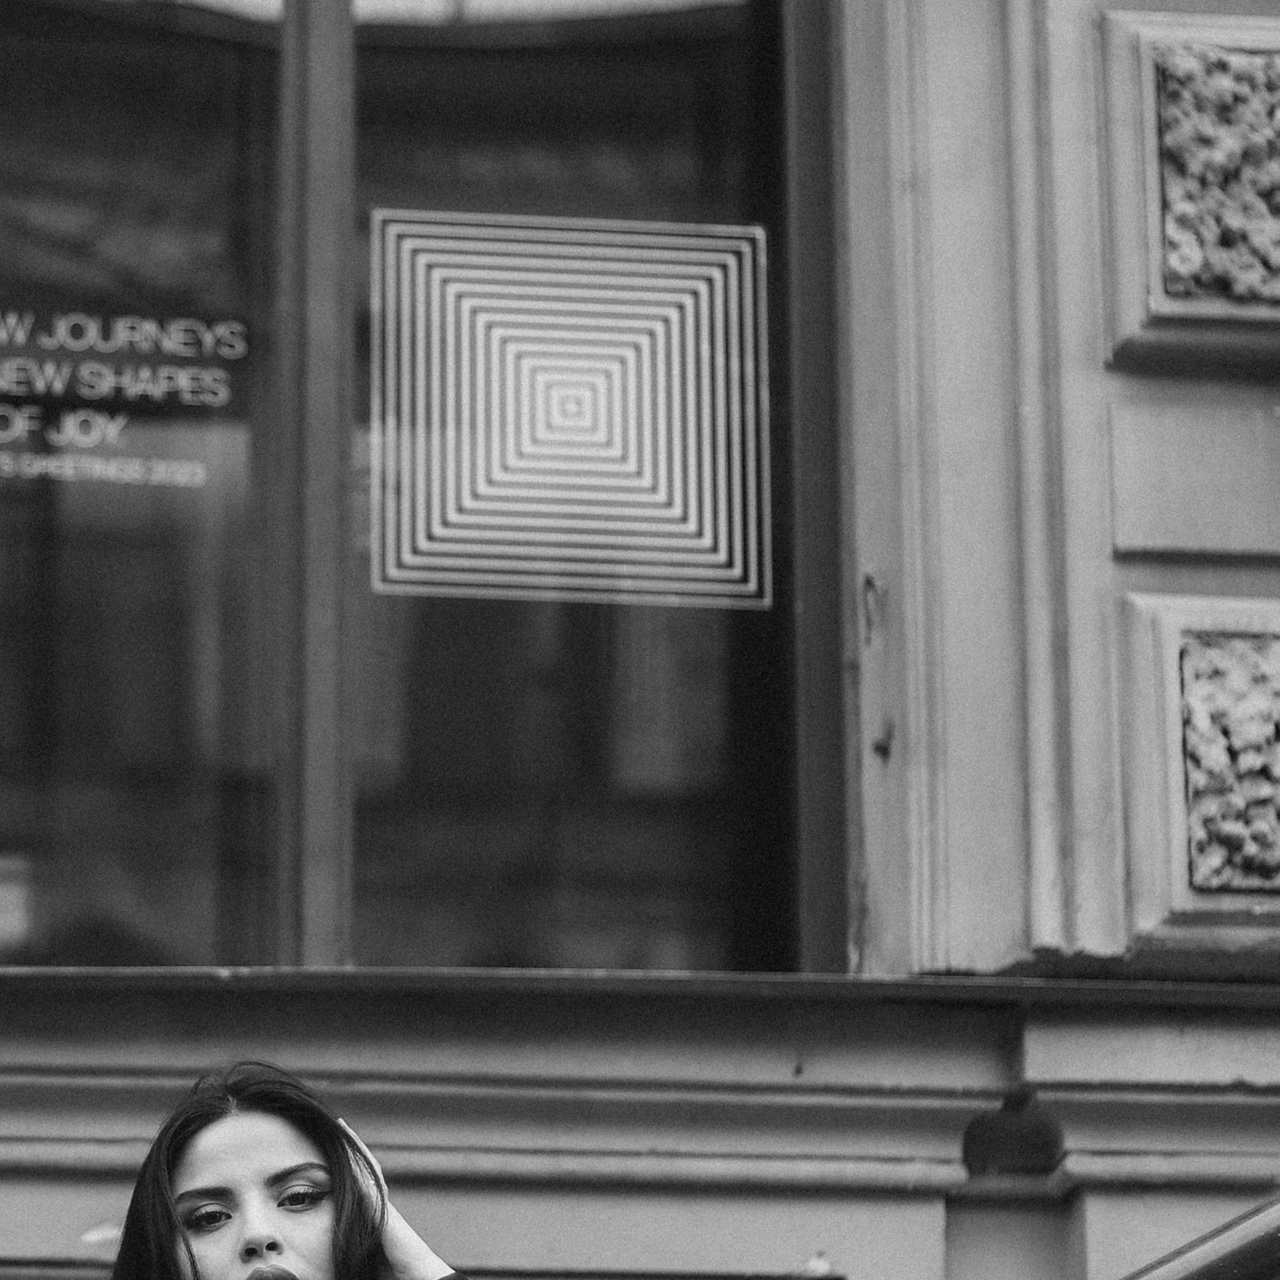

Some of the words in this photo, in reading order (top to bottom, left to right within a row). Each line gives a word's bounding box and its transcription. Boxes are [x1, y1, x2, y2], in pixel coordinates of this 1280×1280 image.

[38, 312, 248, 359] JOURNEYS
[77, 361, 232, 407] SHAPES
[45, 408, 127, 448] JOY
